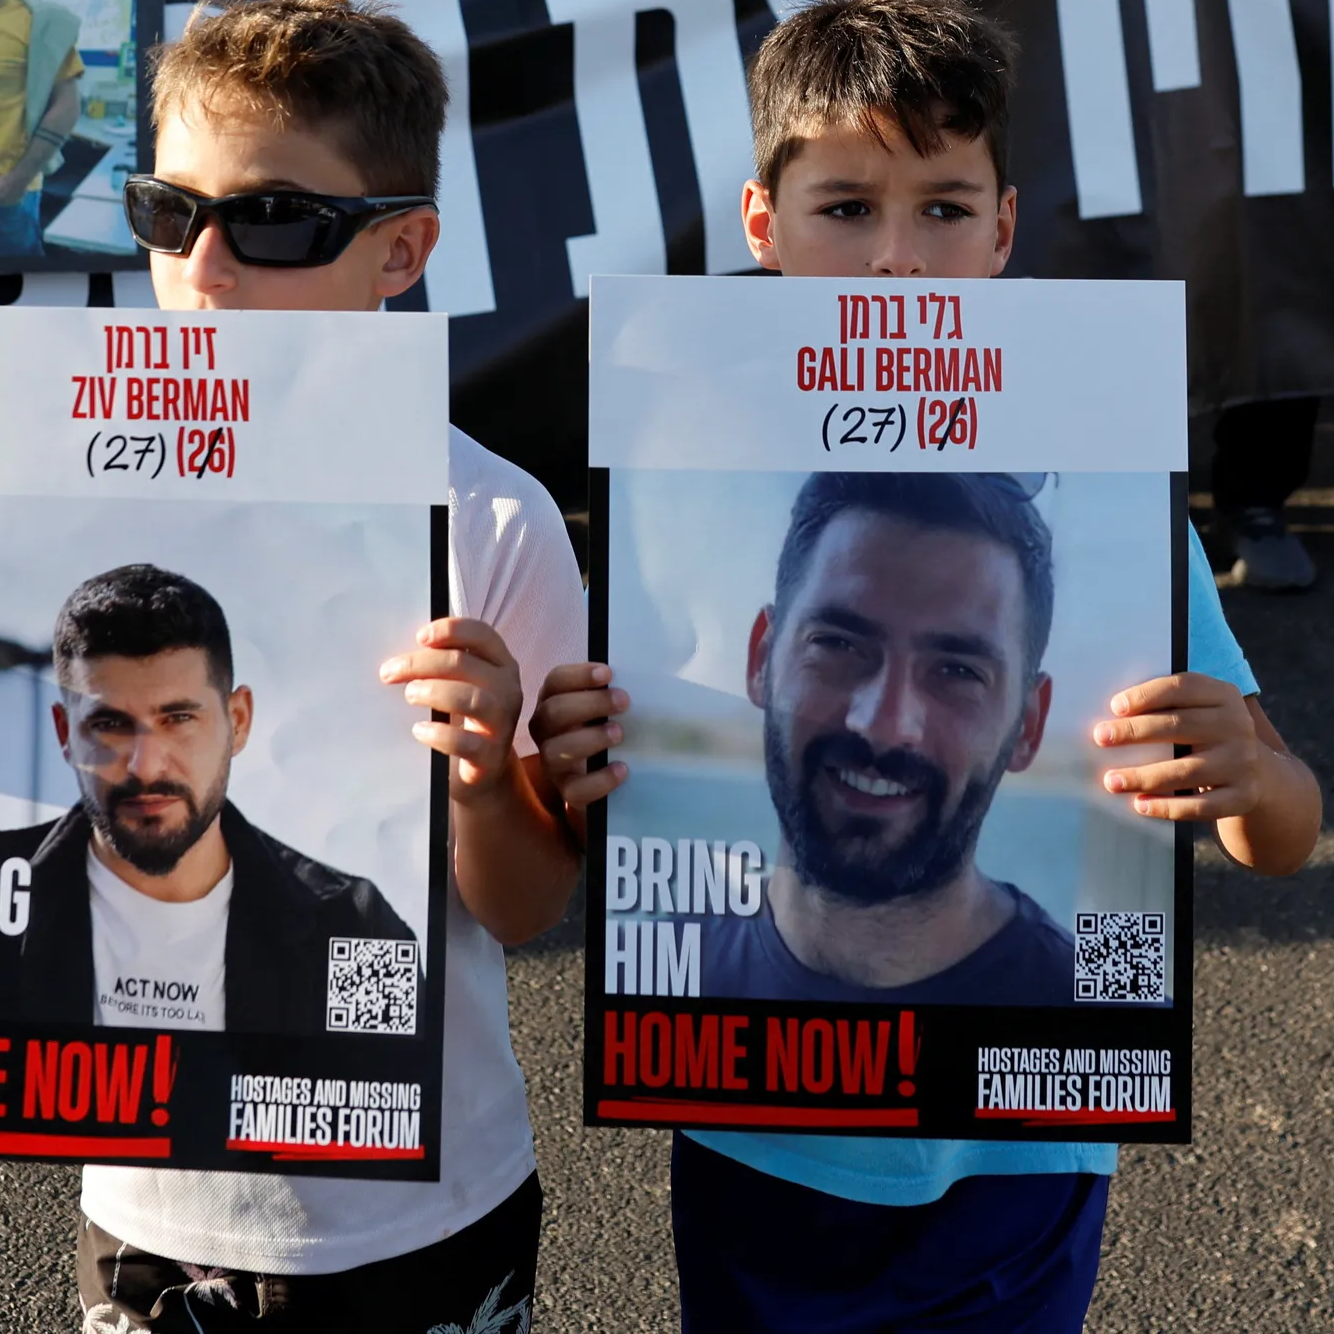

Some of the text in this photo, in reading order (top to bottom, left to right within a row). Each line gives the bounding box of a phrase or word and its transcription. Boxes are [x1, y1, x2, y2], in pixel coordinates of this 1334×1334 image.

[837, 292, 963, 346] גלי ברמן
[104, 325, 217, 374] זיו ברמן
[797, 346, 1003, 392] GALI BERMAN
[72, 377, 250, 422] ZIV BERMAN
[821, 403, 907, 452] (27)
[916, 397, 978, 451] (26)
[86, 432, 167, 480] (27)
[176, 426, 236, 479] (26)
[605, 835, 762, 917] BRING
[604, 921, 702, 998] HIM
[114, 977, 199, 1003] ACT NOW
[160, 1007, 185, 1020] TOO
[603, 1010, 922, 1098] HOME NOW!
[977, 1047, 1171, 1075] HOSTAGES AND MISSING
[22, 1035, 176, 1127] NOW!
[230, 1074, 421, 1110] HOSTAGES AND MISSING
[977, 1073, 1171, 1113] FAMILIES FORUM
[229, 1103, 421, 1150] FAMILIES FORUM
